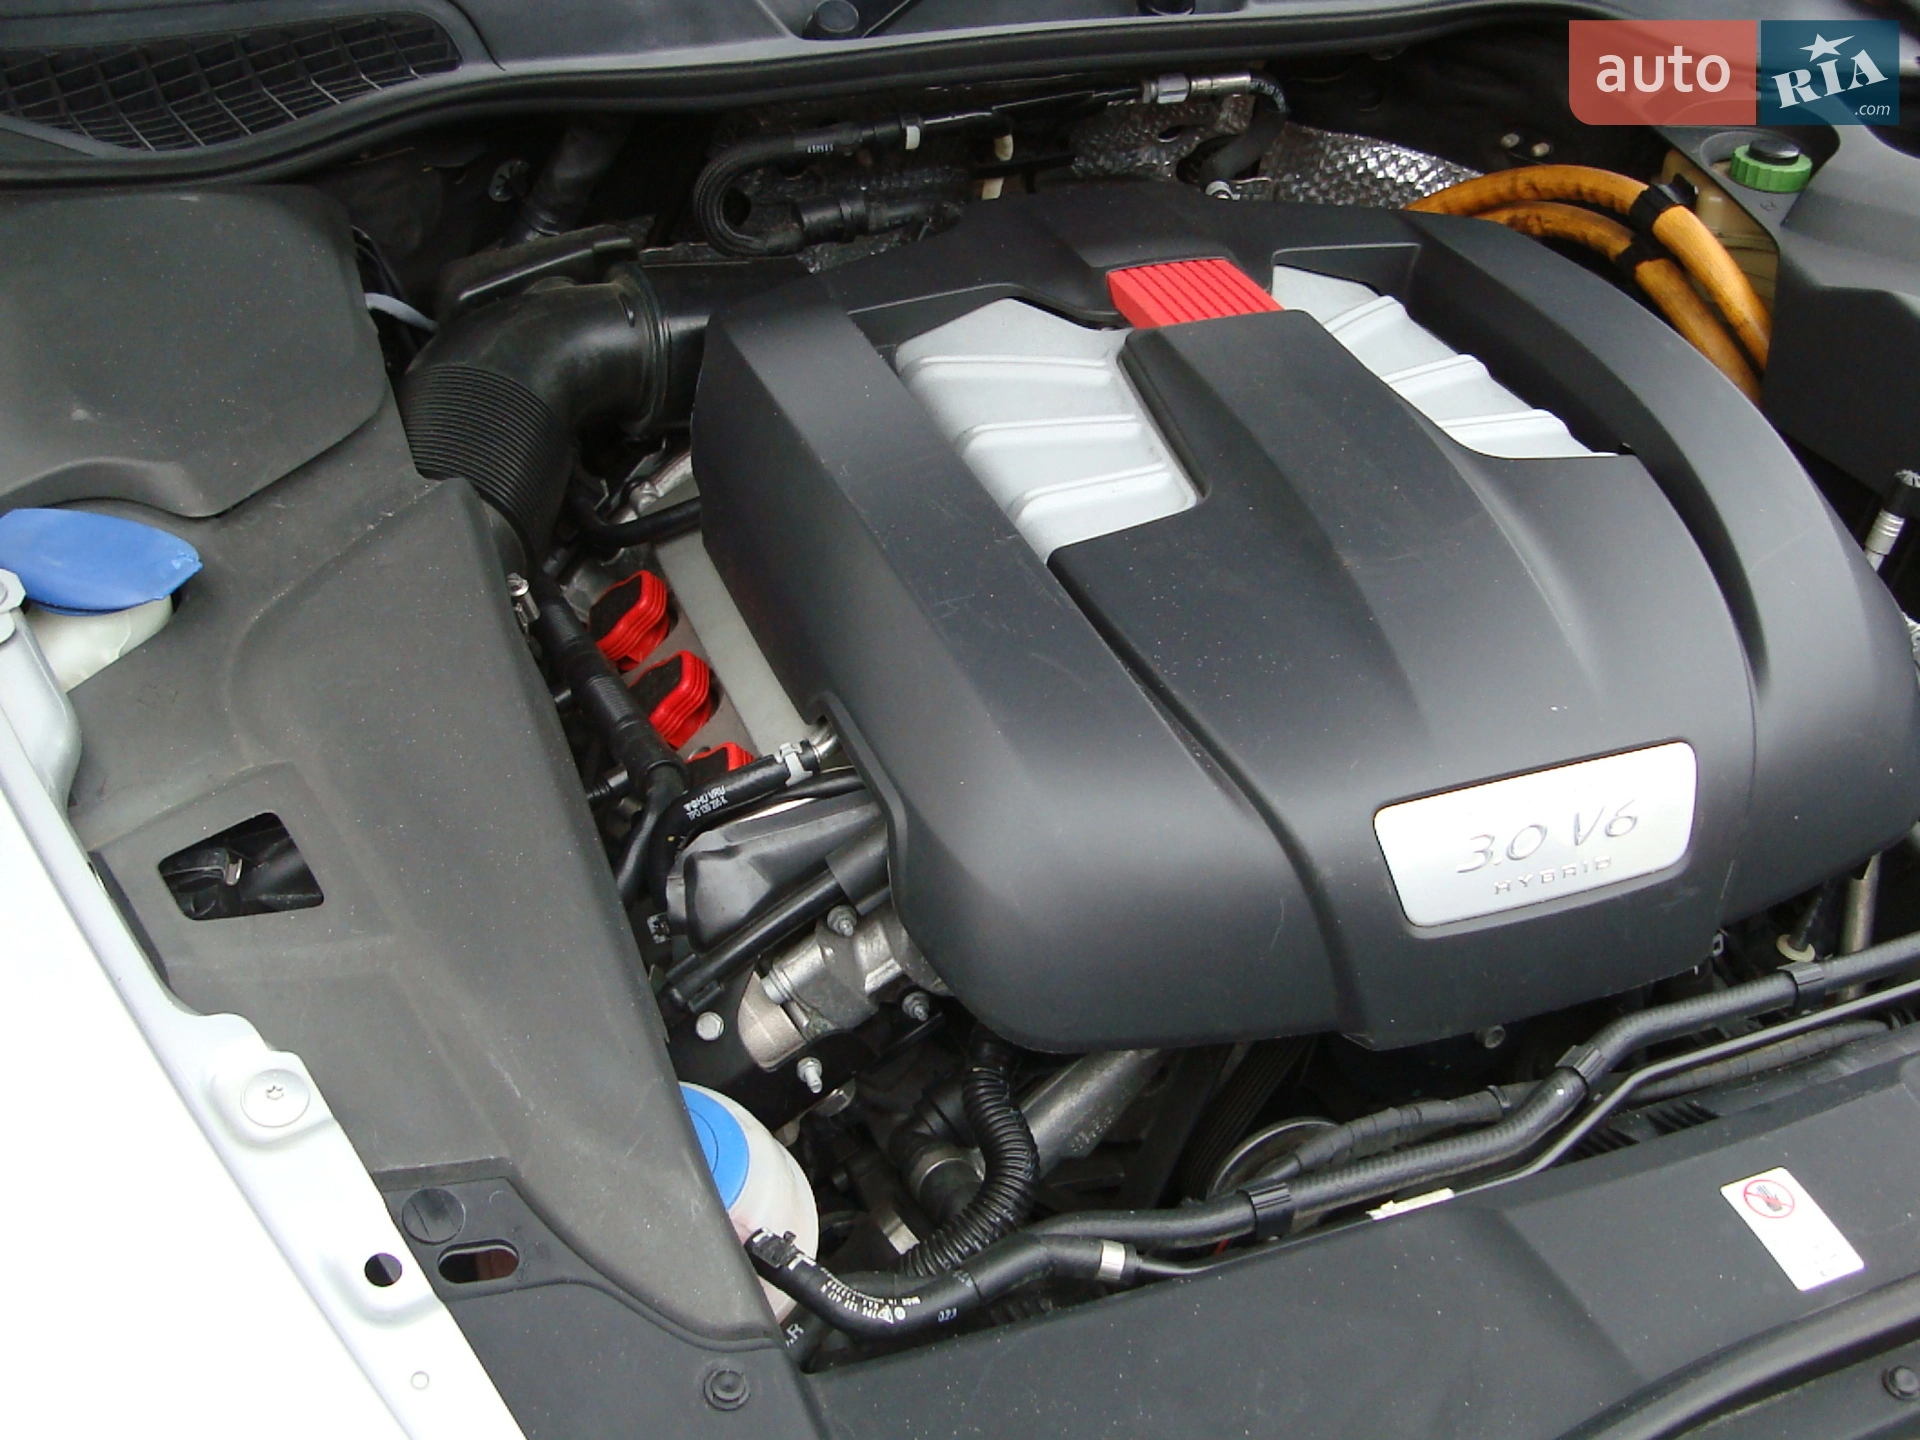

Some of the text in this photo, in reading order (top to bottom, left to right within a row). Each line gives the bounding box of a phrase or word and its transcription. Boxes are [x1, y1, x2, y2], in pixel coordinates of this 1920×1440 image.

[1455, 799, 1638, 874] 3.0 V6
[1494, 855, 1612, 895] HYBRID
